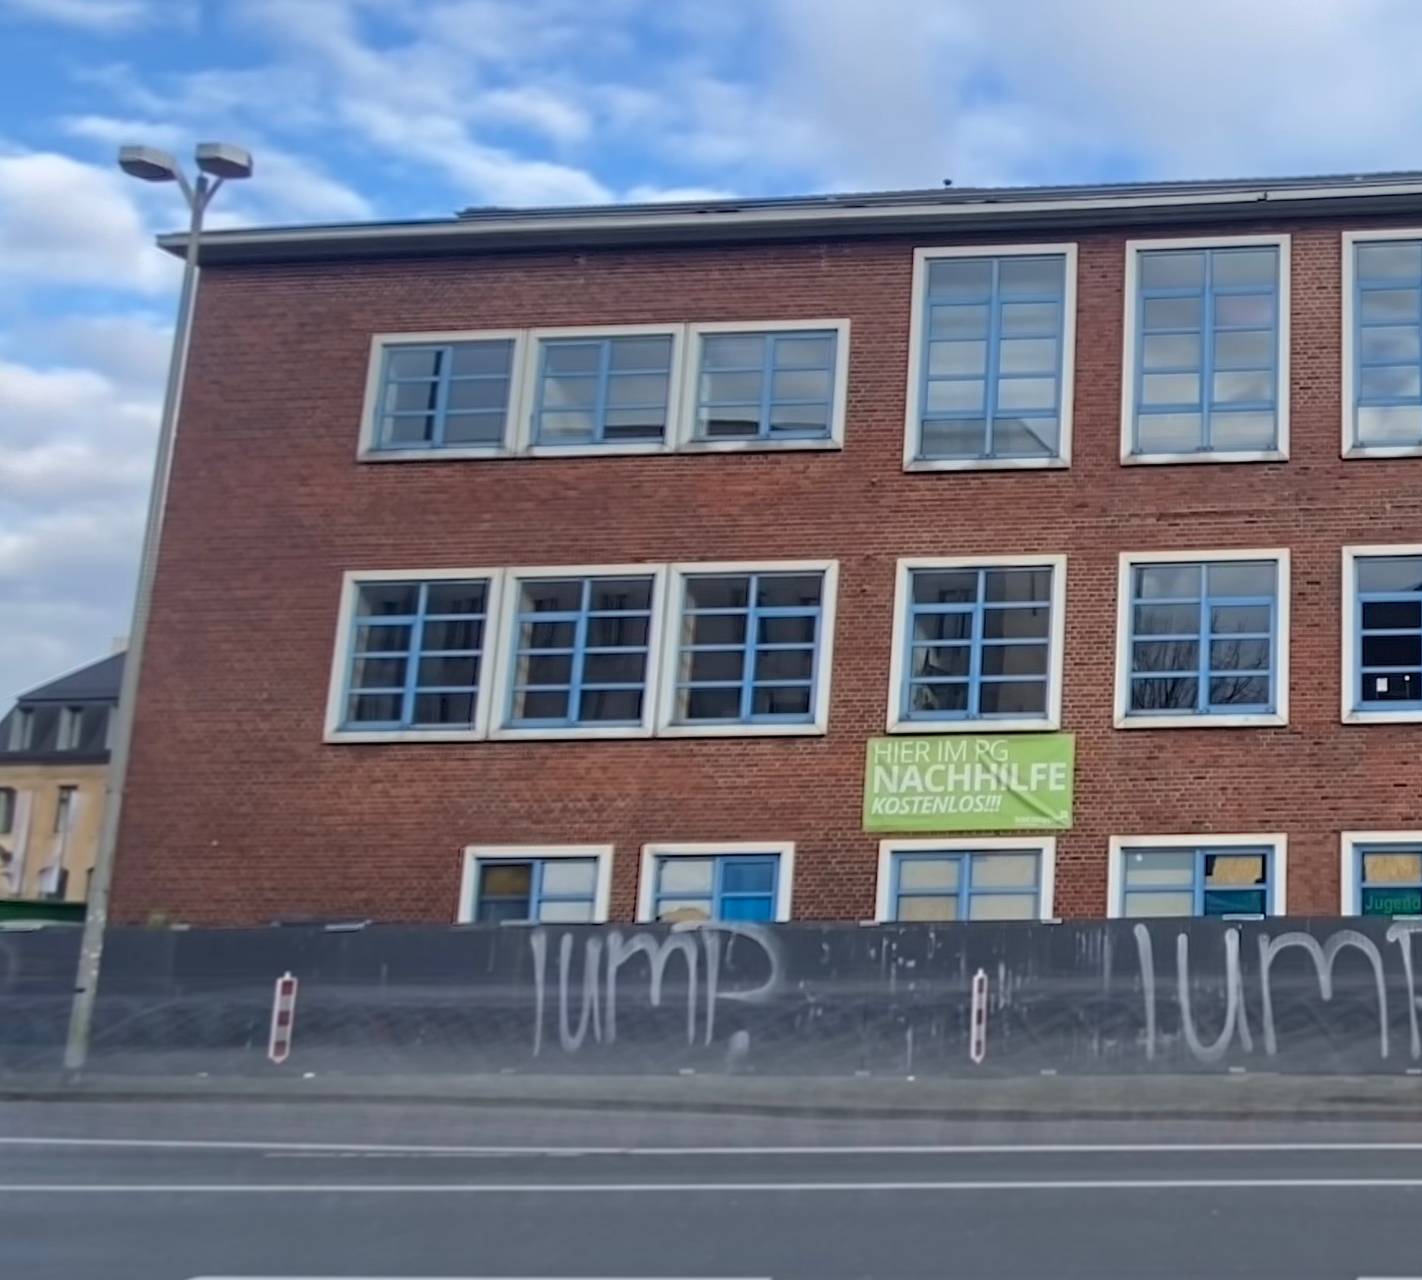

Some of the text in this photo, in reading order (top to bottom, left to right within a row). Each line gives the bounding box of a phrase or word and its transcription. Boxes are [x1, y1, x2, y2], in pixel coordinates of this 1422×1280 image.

[873, 739, 1009, 764] HIER IM PG
[872, 762, 1067, 794] NACHHILFE
[871, 794, 1003, 816] KOSTENLOS!!!
[1365, 894, 1421, 915] Jugend
